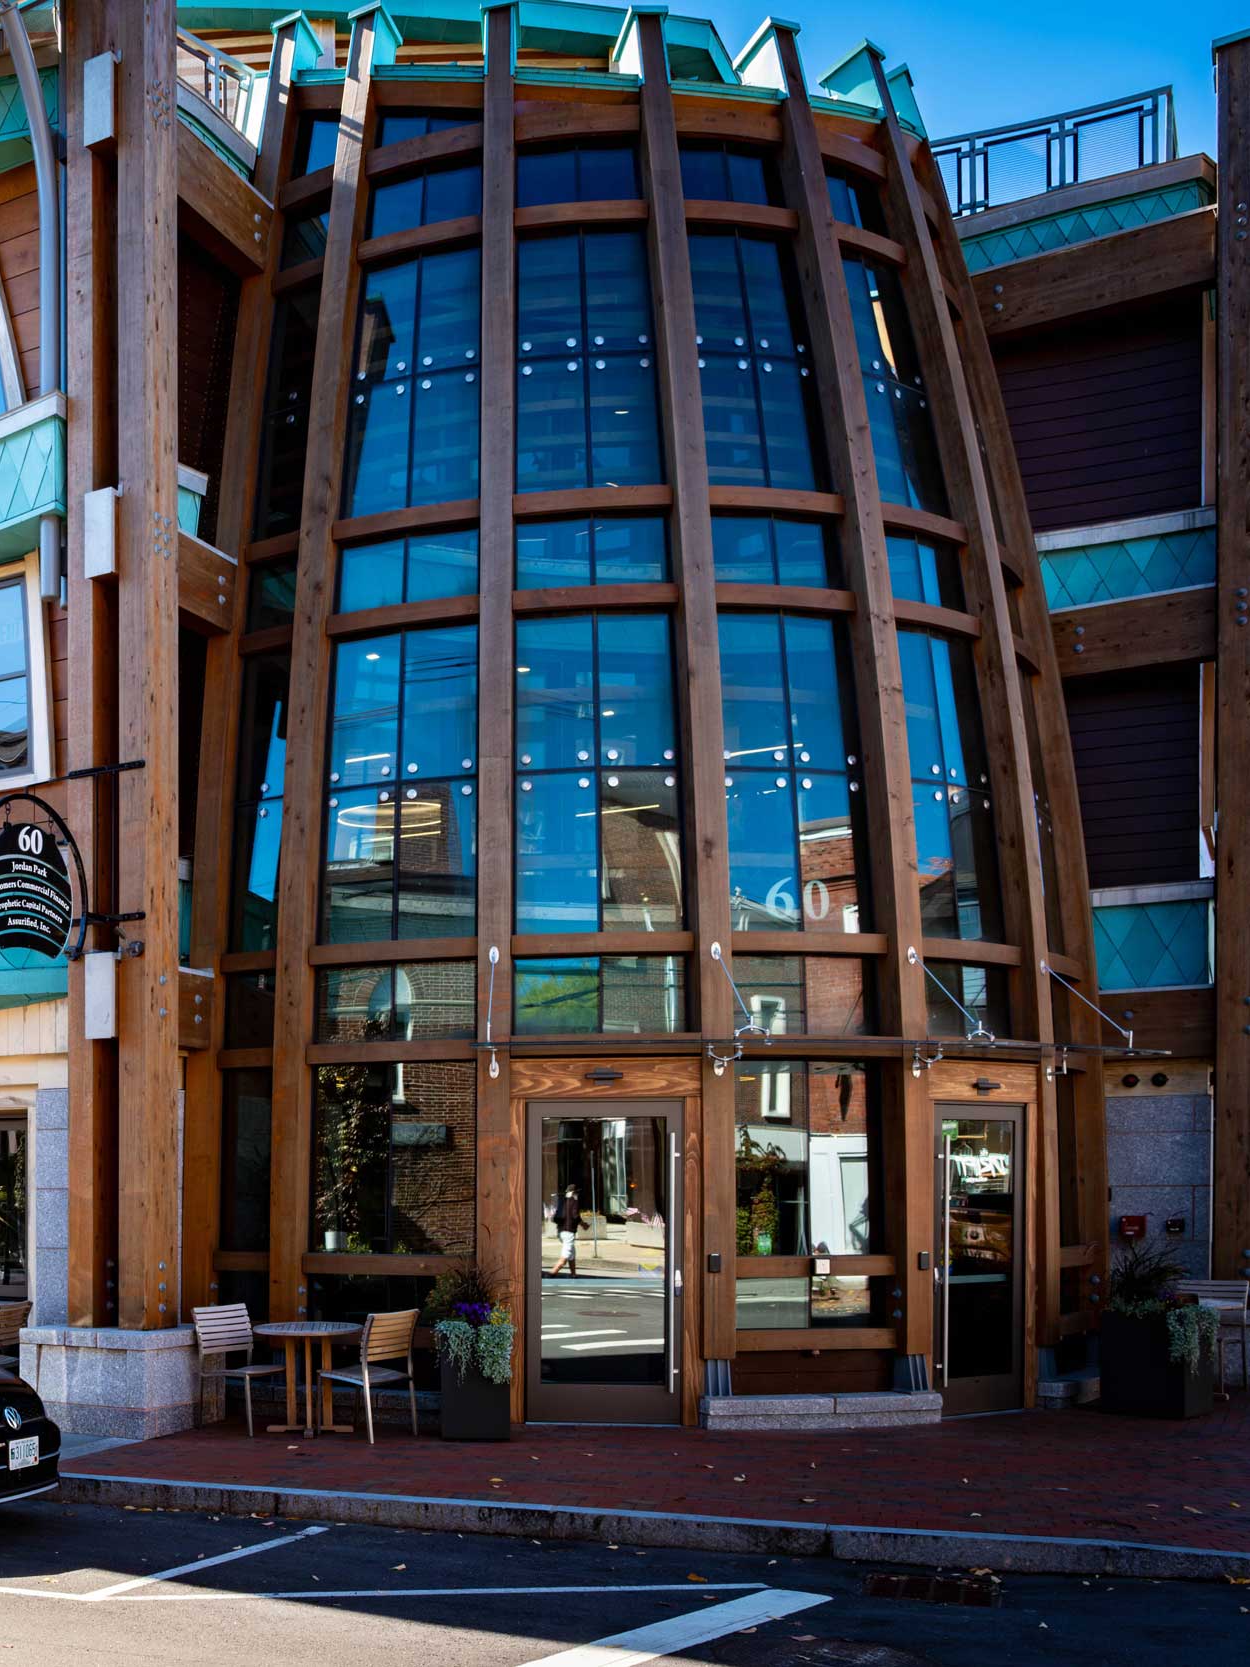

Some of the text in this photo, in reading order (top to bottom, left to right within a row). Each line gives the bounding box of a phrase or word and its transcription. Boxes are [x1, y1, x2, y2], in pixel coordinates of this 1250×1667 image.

[18, 825, 44, 855] 60
[11, 861, 48, 877] Jordan Park
[17, 879, 50, 896] Commercial
[49, 889, 70, 912] Finance
[765, 876, 830, 920] 60
[7, 916, 51, 933] Assurified, Inc.
[21, 899, 41, 912] Capital
[41, 906, 63, 924] Partners
